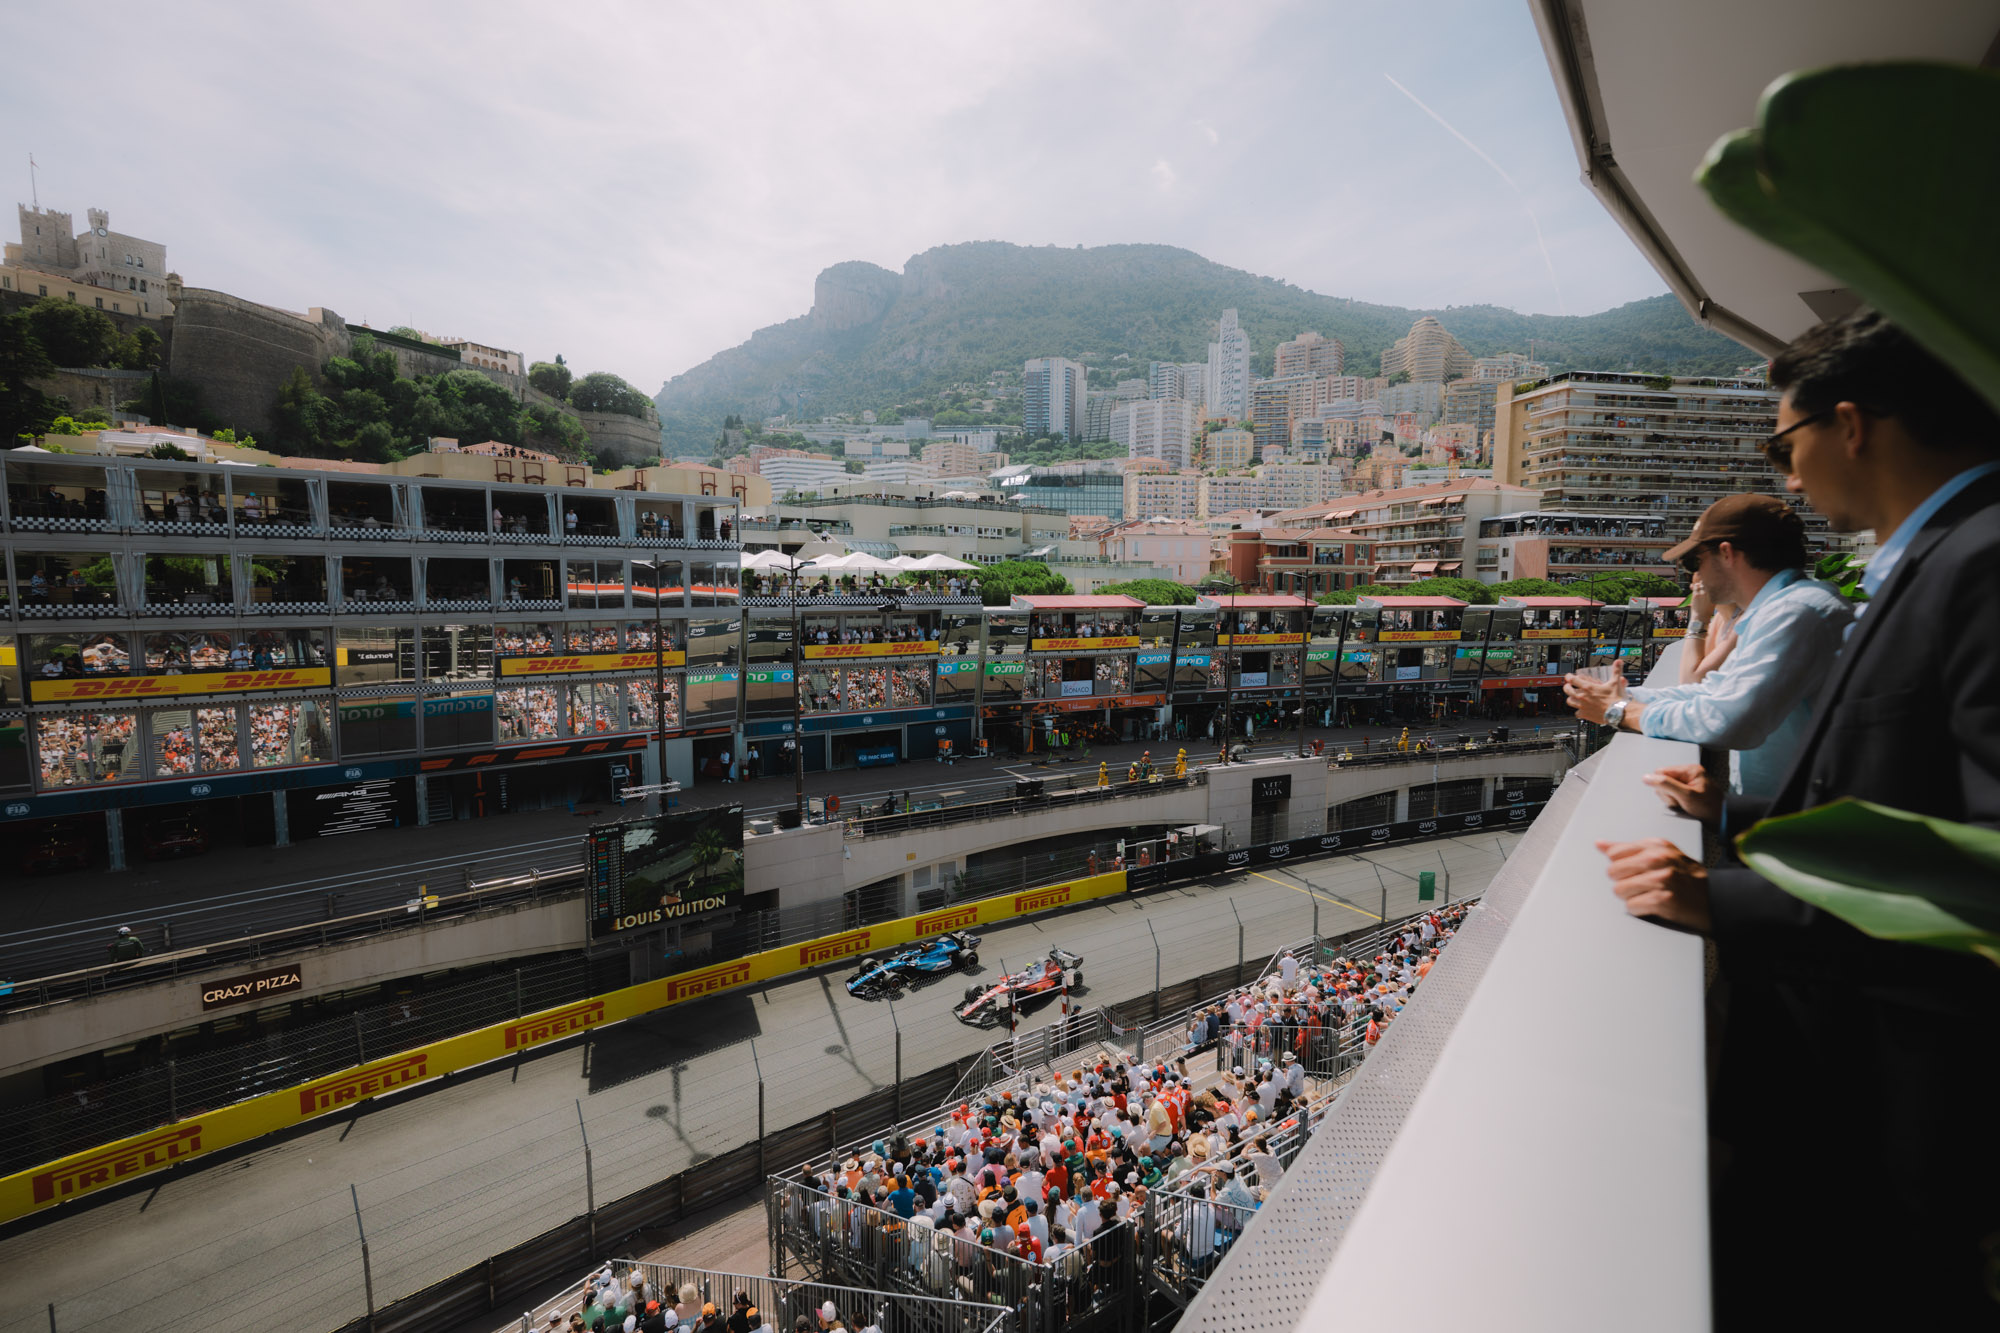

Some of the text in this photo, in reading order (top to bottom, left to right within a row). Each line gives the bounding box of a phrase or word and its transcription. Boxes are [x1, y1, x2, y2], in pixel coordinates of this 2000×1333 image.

[1233, 635, 1260, 643] DHL
[1279, 634, 1302, 642] DHL
[1392, 632, 1417, 640] DHL
[893, 643, 926, 653] DHL
[1047, 640, 1081, 648] DHL
[1103, 638, 1130, 647] DHL
[824, 645, 866, 655] DHL
[528, 658, 583, 671] DHL
[224, 672, 296, 688] DHL
[72, 679, 162, 696] DHL
[1063, 686, 1090, 694] MONACO
[784, 741, 796, 749] FIA
[345, 769, 362, 778] FIA
[191, 784, 210, 795] FIA
[6, 803, 30, 815] FIA
[1015, 887, 1071, 912] PIRELLI
[615, 894, 727, 931] LOUIS VUITTON
[916, 907, 978, 937] PIRELLI
[800, 932, 871, 966] PIRELLI
[203, 972, 300, 1004] CRAZY PIZZA
[668, 963, 751, 1001] PIRELLI
[505, 1001, 605, 1049] PIRELLI
[300, 1053, 428, 1115] PIRELLI
[32, 1125, 203, 1205] PIRELLI
